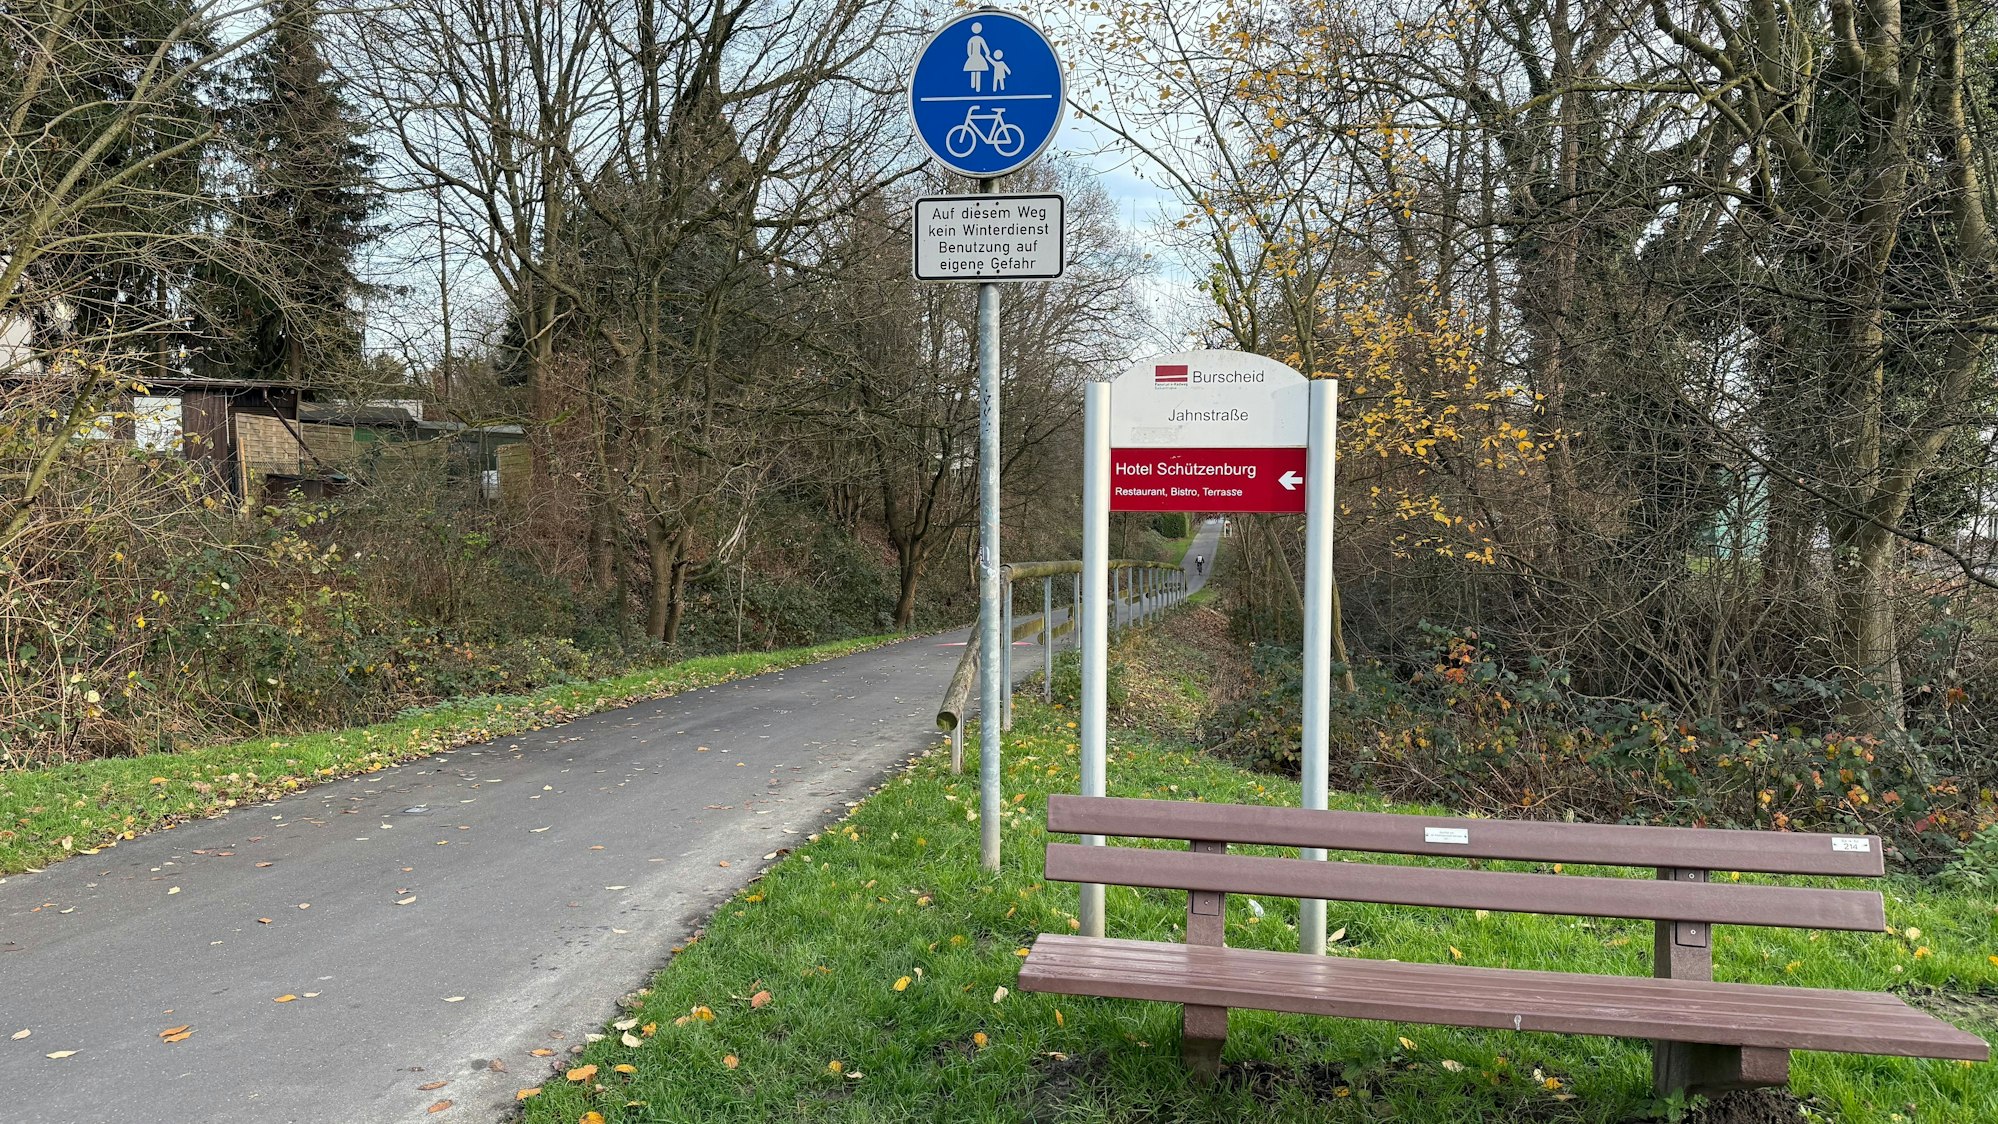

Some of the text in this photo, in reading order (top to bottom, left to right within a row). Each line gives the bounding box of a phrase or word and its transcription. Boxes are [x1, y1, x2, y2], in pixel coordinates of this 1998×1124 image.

[932, 205, 1046, 220] Auf diesem Weg
[928, 223, 1049, 237] kein Winterdienst
[939, 240, 1038, 255] Benutzung auf
[940, 257, 1036, 273] eigene Gefahr
[1192, 370, 1265, 383] Burscheid
[1168, 408, 1249, 422] Jahnstraße
[1115, 461, 1257, 479] Hotel Schützenburg
[1115, 487, 1243, 498] Restaurant, Bistro, Terrasse
